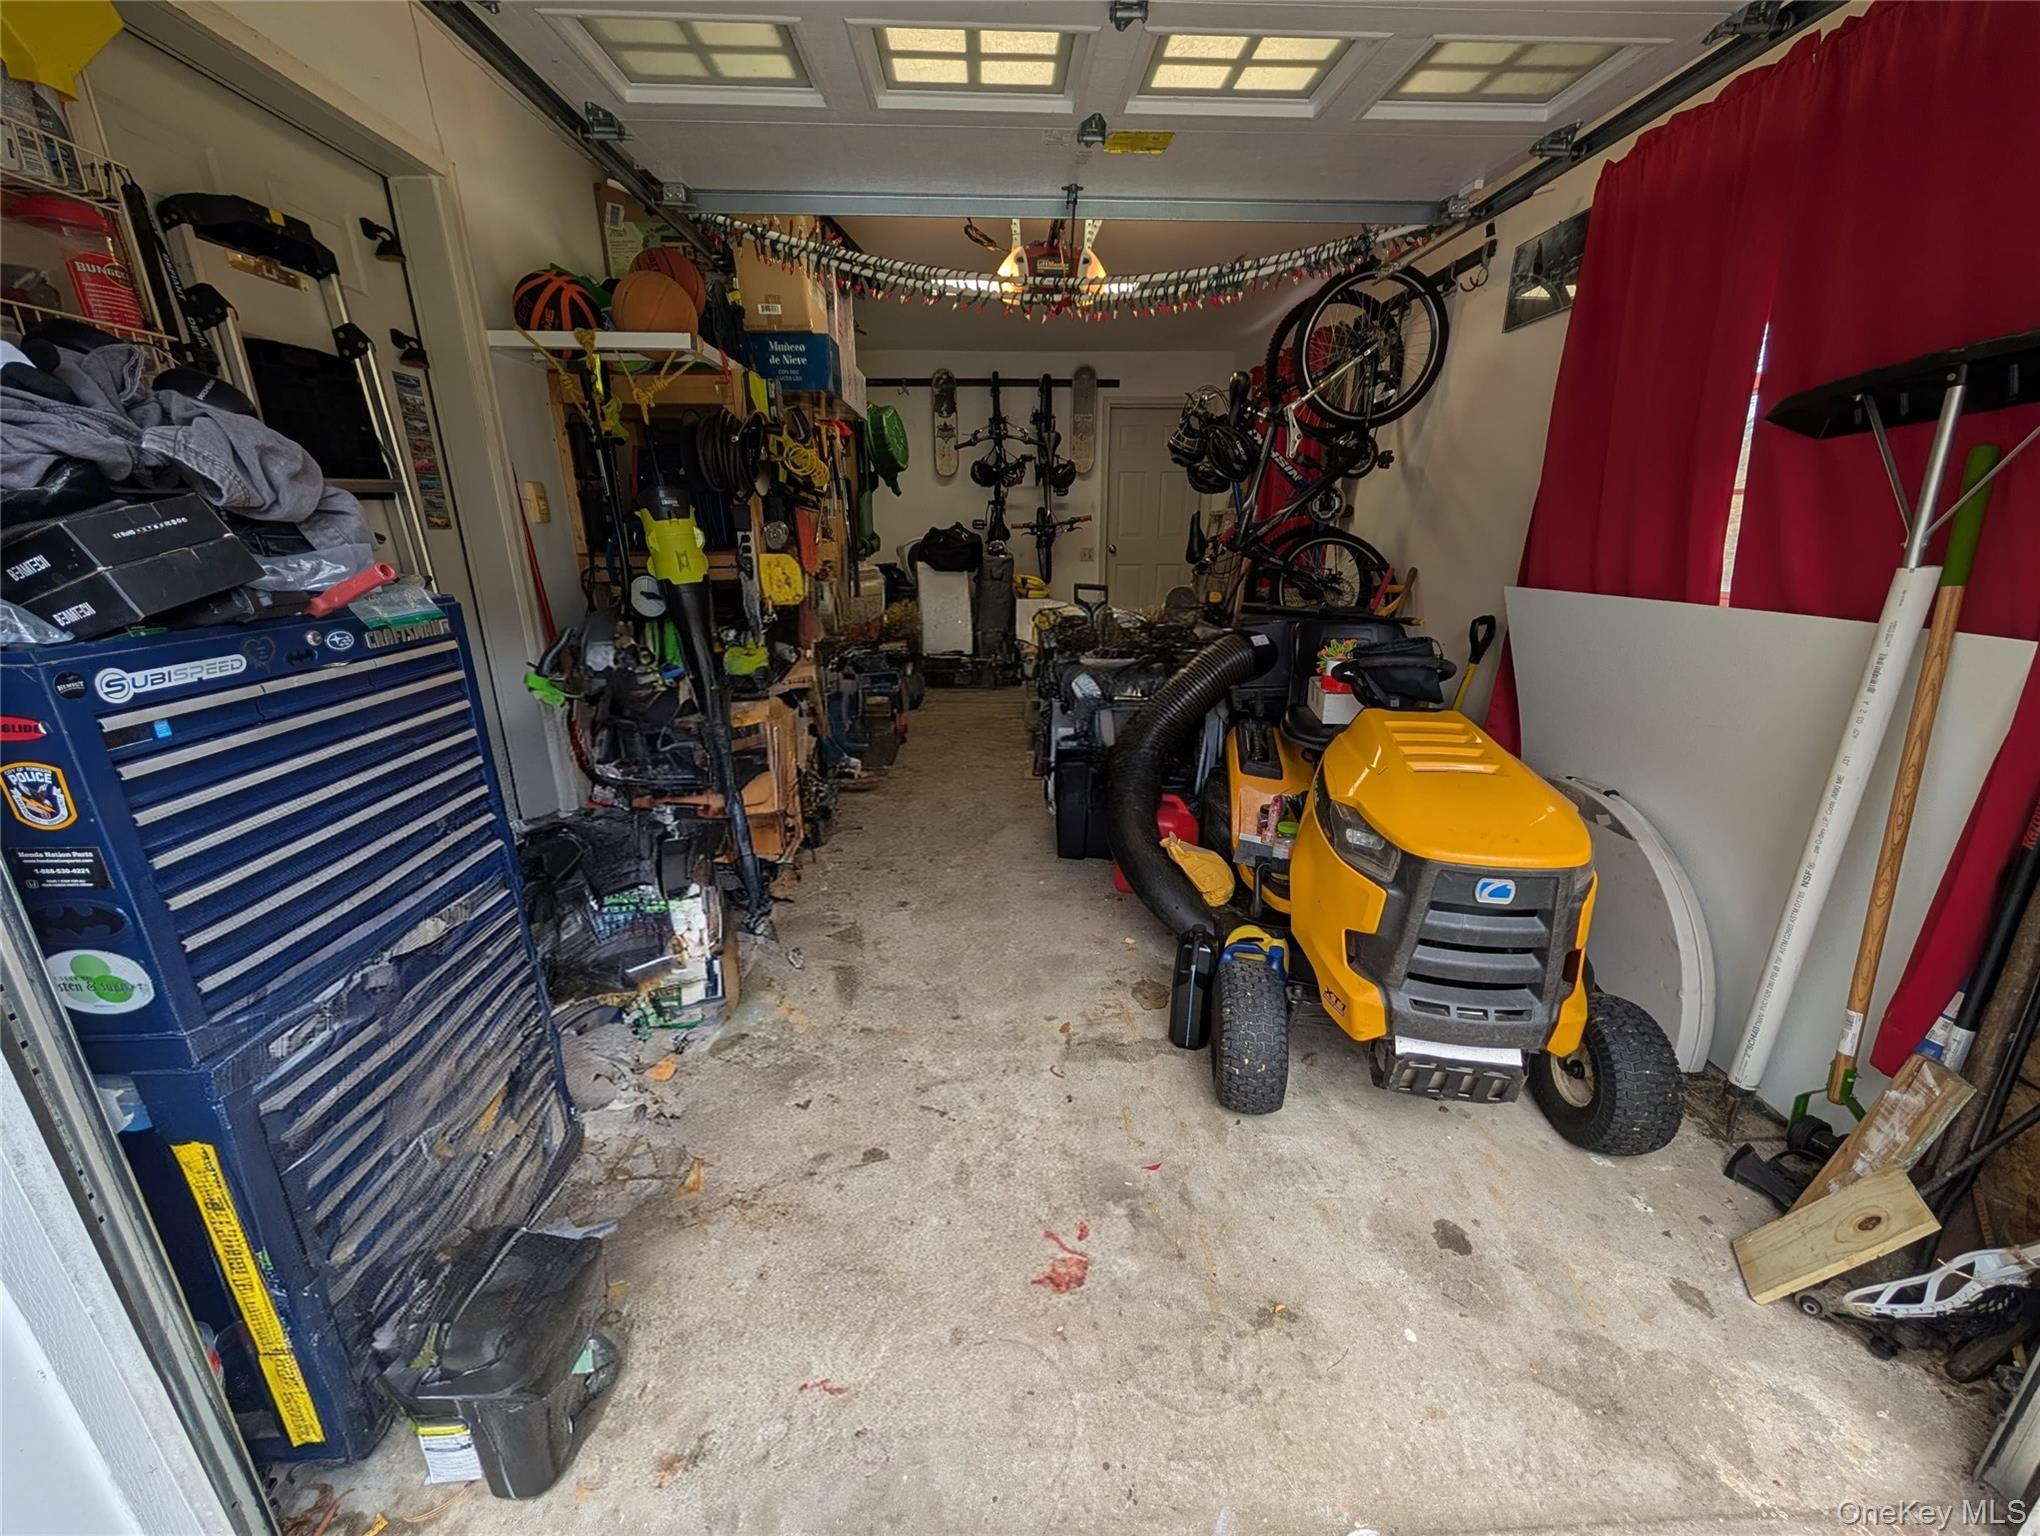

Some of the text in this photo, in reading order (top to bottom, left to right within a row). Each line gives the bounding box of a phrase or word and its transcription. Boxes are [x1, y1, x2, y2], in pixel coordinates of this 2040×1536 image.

[769, 354, 808, 365] de Nieve
[102, 657, 243, 698] SUBISPEED
[7, 772, 52, 786] POLICE
[1324, 986, 1346, 1011] XT1
